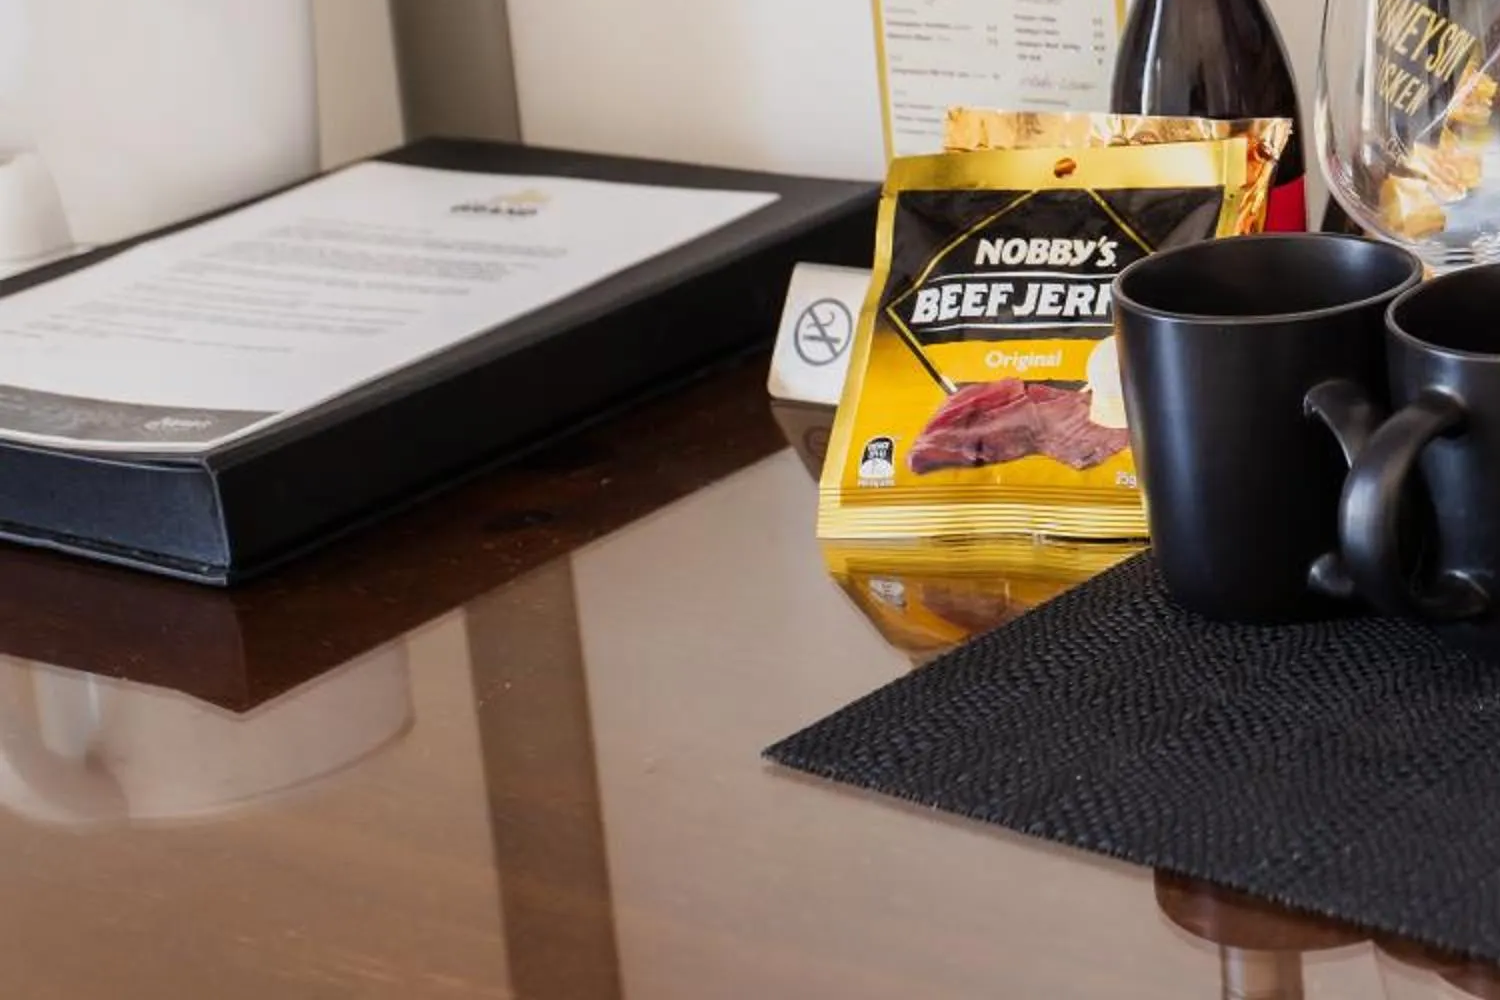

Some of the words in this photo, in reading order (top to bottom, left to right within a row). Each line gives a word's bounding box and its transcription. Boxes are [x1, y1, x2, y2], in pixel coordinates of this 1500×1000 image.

[974, 236, 1119, 267] NOBBY'S
[911, 284, 1016, 325] BEEF
[1012, 283, 1113, 319] JER
[984, 350, 1062, 371] Original
